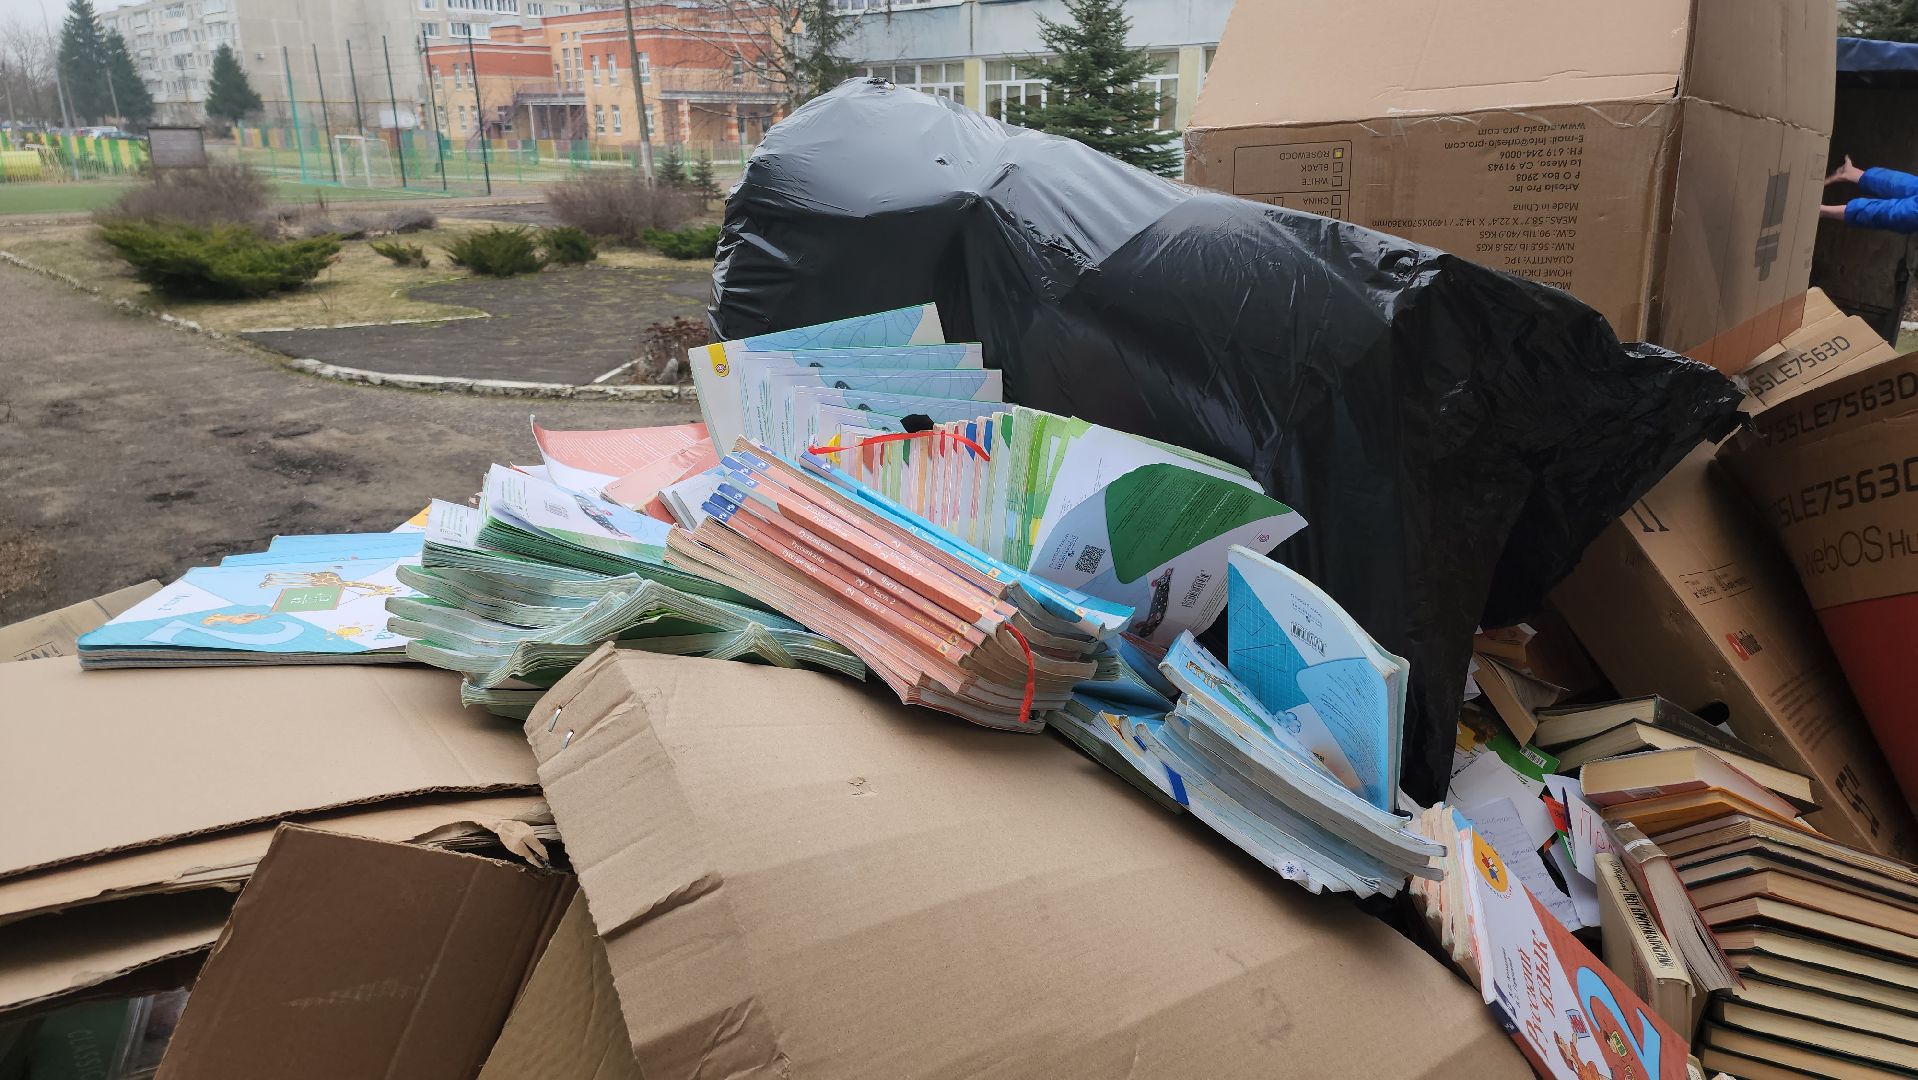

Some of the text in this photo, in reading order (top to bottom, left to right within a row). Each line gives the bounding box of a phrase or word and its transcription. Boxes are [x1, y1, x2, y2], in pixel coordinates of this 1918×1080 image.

[1300, 163, 1329, 172] BLACK
[1487, 159, 1582, 172] La Mesa, CA 91943
[1541, 172, 1560, 180] Box
[1301, 177, 1328, 186] WHITE
[1508, 184, 1523, 193] Inc
[1526, 184, 1542, 192] Pro
[1302, 197, 1329, 205] CHINA
[1512, 202, 1579, 212] Made in China
[1480, 230, 1497, 238] KGS
[1476, 243, 1493, 251] KGS
[1523, 255, 1574, 264] QUANTITY:
[1543, 269, 1573, 277] HOME
[1515, 943, 1550, 1063] Русский
